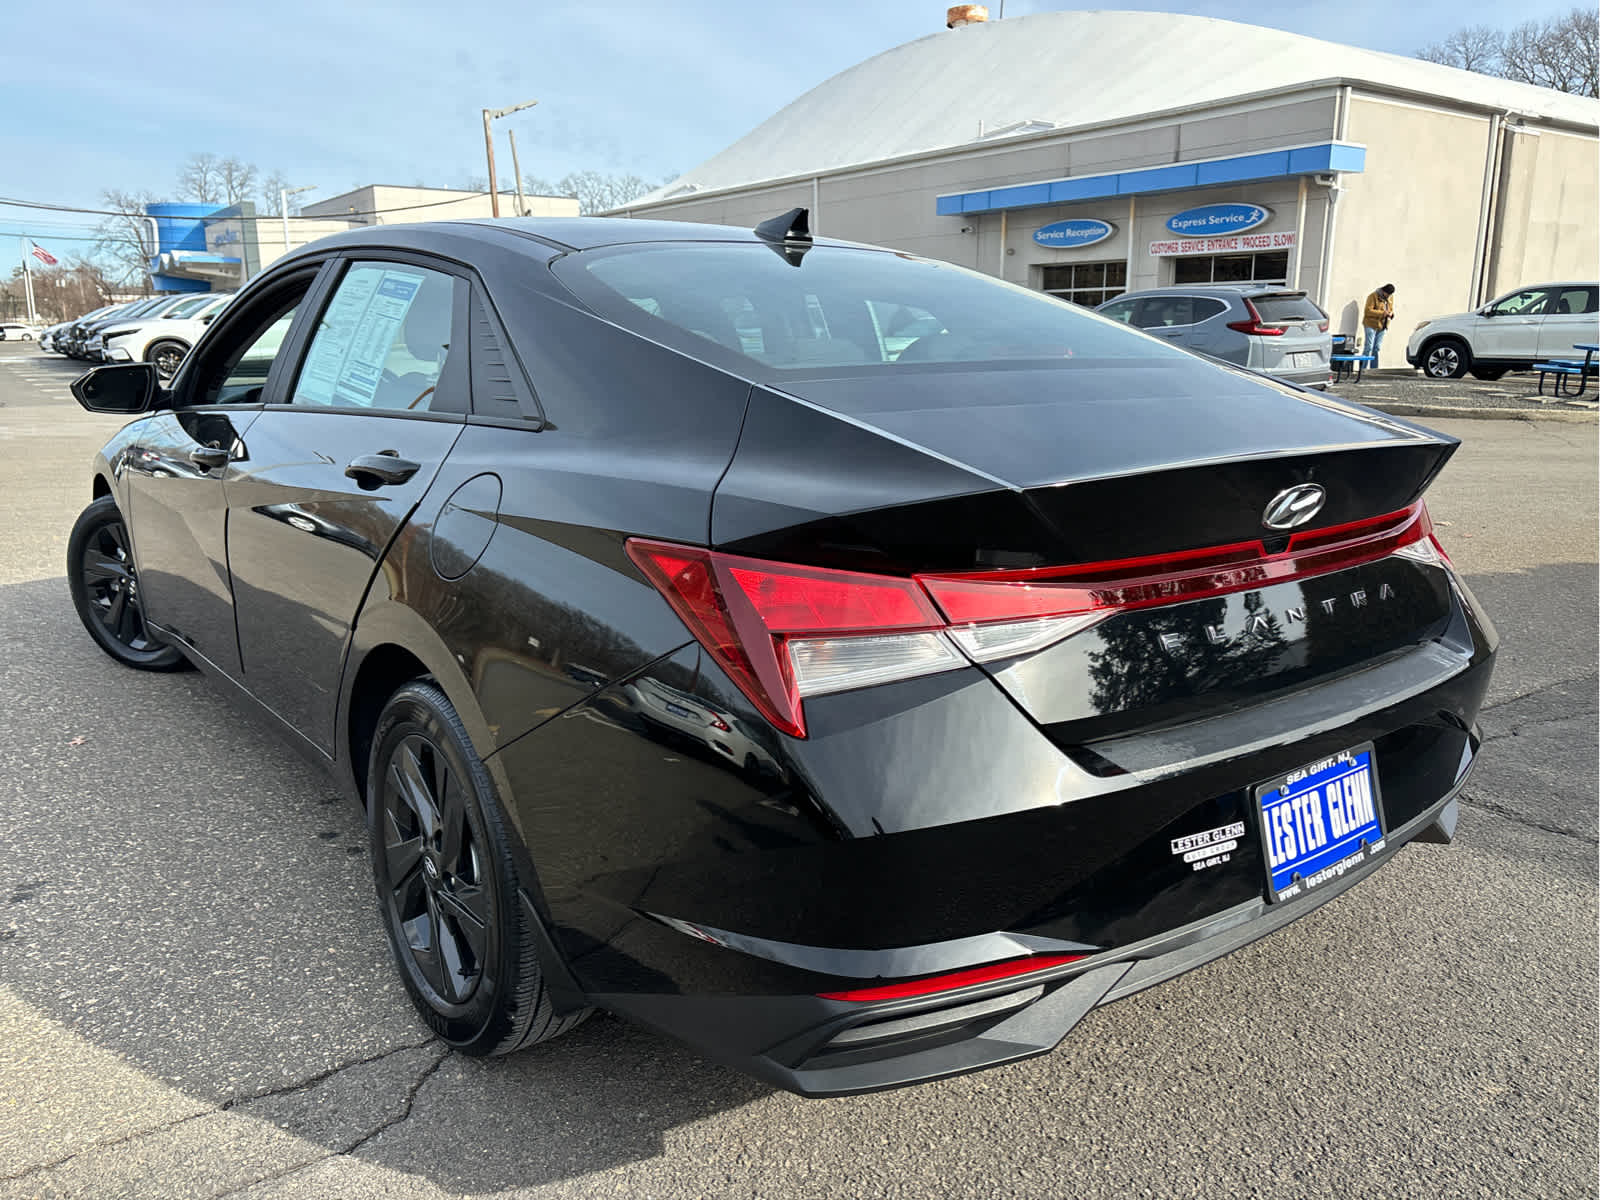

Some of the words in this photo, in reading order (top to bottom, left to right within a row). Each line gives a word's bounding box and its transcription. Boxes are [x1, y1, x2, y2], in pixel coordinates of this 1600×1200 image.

[1036, 230, 1064, 240] Service
[1066, 226, 1106, 239] Reception
[1172, 217, 1206, 230] Express
[1208, 214, 1245, 225] Service
[1151, 242, 1179, 254] CUSTOMER
[1181, 240, 1205, 252] SERVICE
[1207, 238, 1238, 251] ENTRANCE
[1242, 235, 1271, 248] PROCEED
[1158, 582, 1396, 652] ELANTRA
[1286, 769, 1308, 786] SEA
[1310, 758, 1336, 776] GIRT,
[1337, 751, 1352, 763] NJ
[1263, 790, 1328, 869] LESTER
[1326, 768, 1375, 840] GLENN
[1172, 834, 1211, 852] LESTER
[1212, 823, 1244, 841] GLENN
[1193, 861, 1206, 871] SEA
[1305, 851, 1365, 889] lesterglenn
